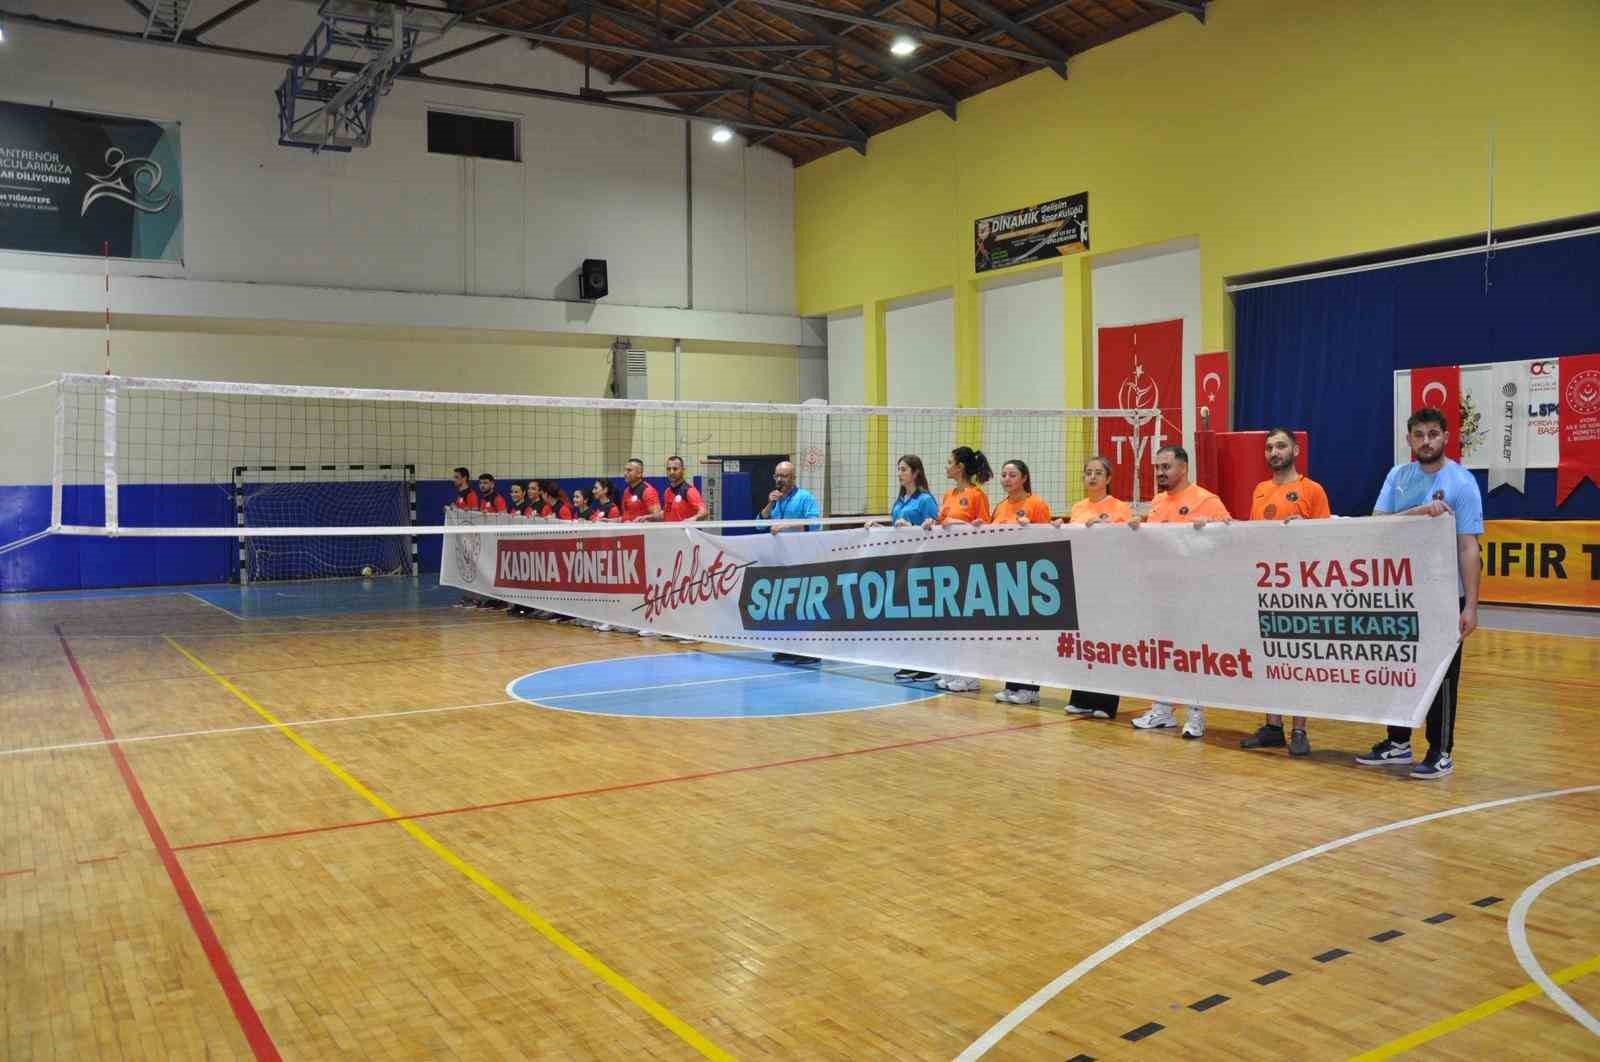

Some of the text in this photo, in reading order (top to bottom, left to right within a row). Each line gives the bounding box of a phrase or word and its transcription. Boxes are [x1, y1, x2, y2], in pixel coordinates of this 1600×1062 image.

[991, 208, 1039, 233] DİNAMİK
[500, 538, 641, 586] KADINA YÖNELİK
[1255, 558, 1413, 588] 25 KASIM
[1479, 541, 1568, 579] IFIR
[643, 544, 741, 624] şiddete
[748, 559, 1061, 622] SIFIR TOLERANS
[1258, 589, 1415, 609] KADINA YÖNELİK
[1260, 612, 1417, 641] ŞİDDETE KARŞI
[1056, 631, 1253, 679] #işaretiFarket
[1263, 641, 1417, 663] ULUSLARARASI
[1266, 663, 1416, 688] MÜCADELE GÜNÜ
